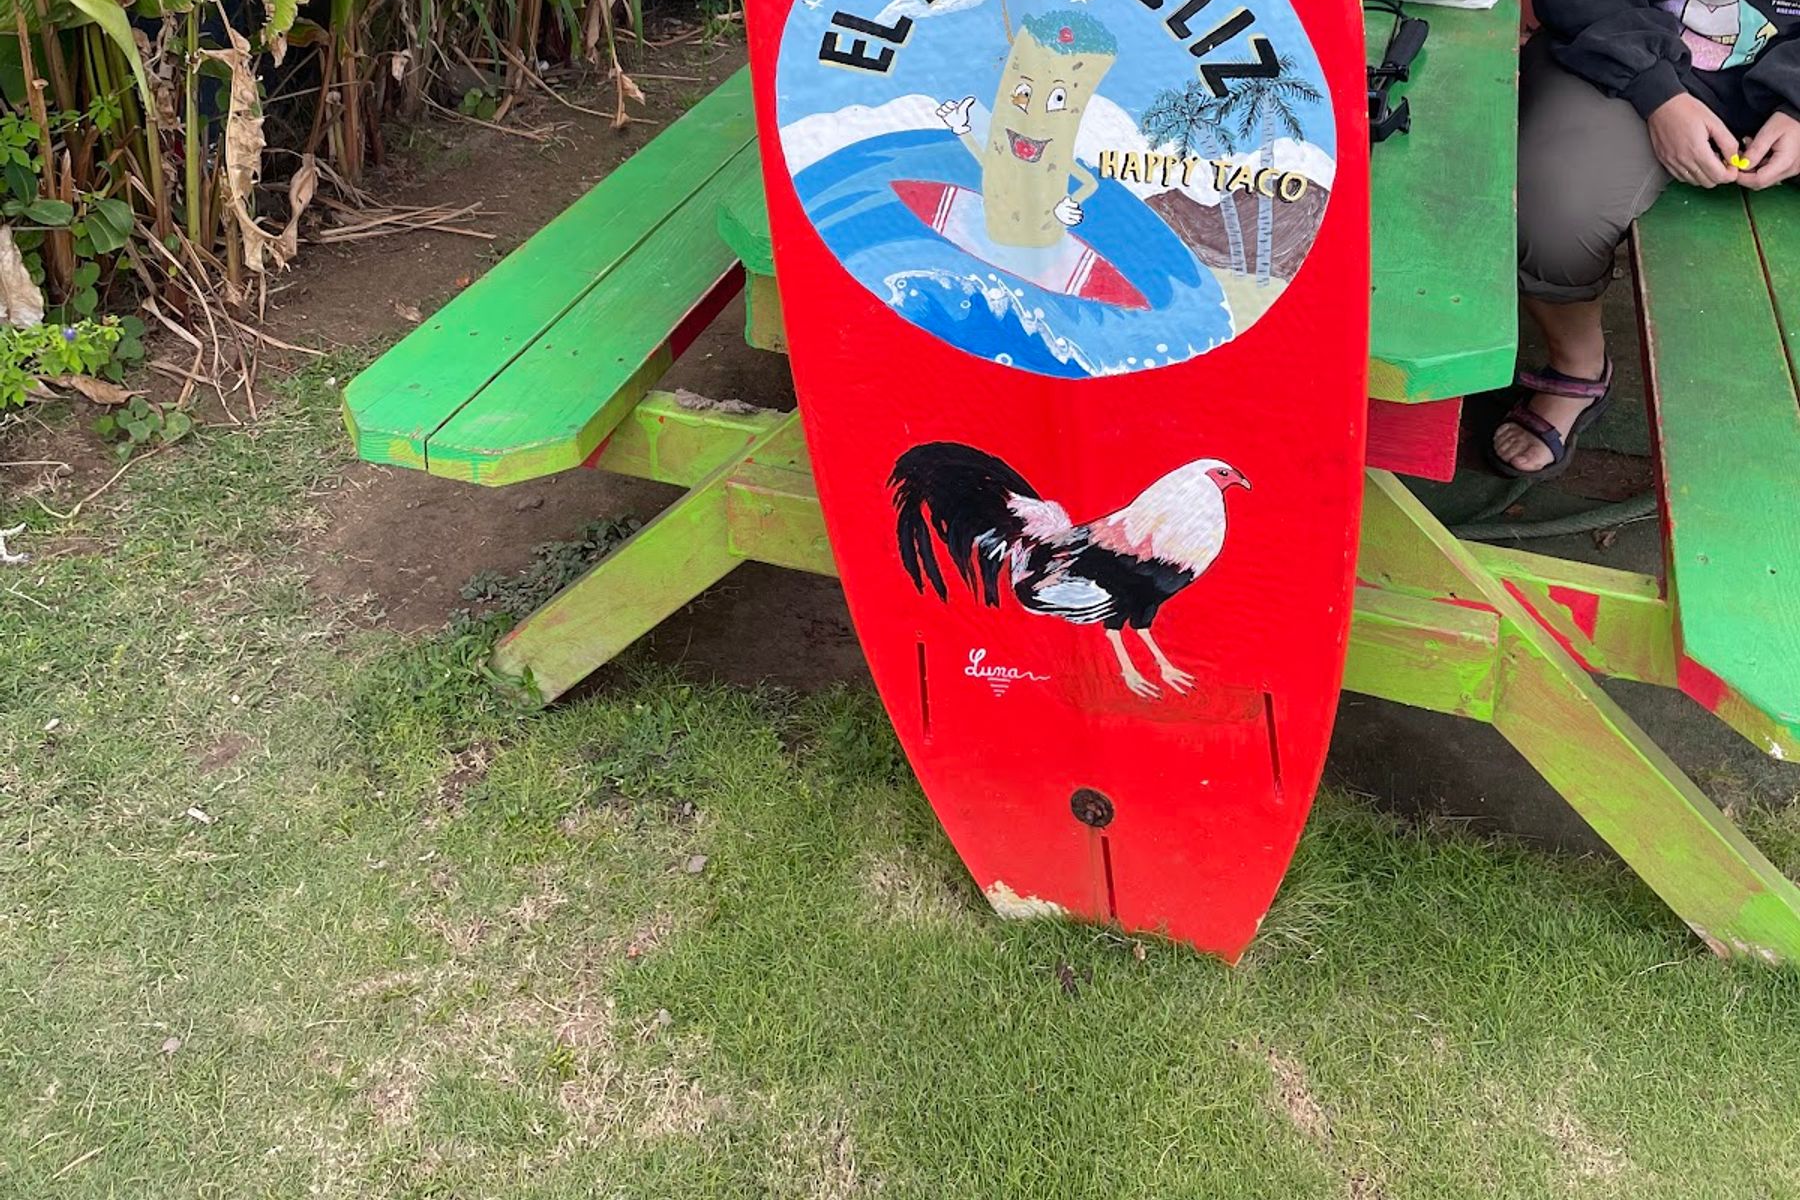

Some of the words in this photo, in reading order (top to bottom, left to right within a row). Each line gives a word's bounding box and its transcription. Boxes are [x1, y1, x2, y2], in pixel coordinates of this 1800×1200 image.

[818, 11, 914, 74] EL
[1099, 150, 1199, 188] HAPPY
[1209, 160, 1308, 204] TACO
[964, 648, 1050, 681] Luna
